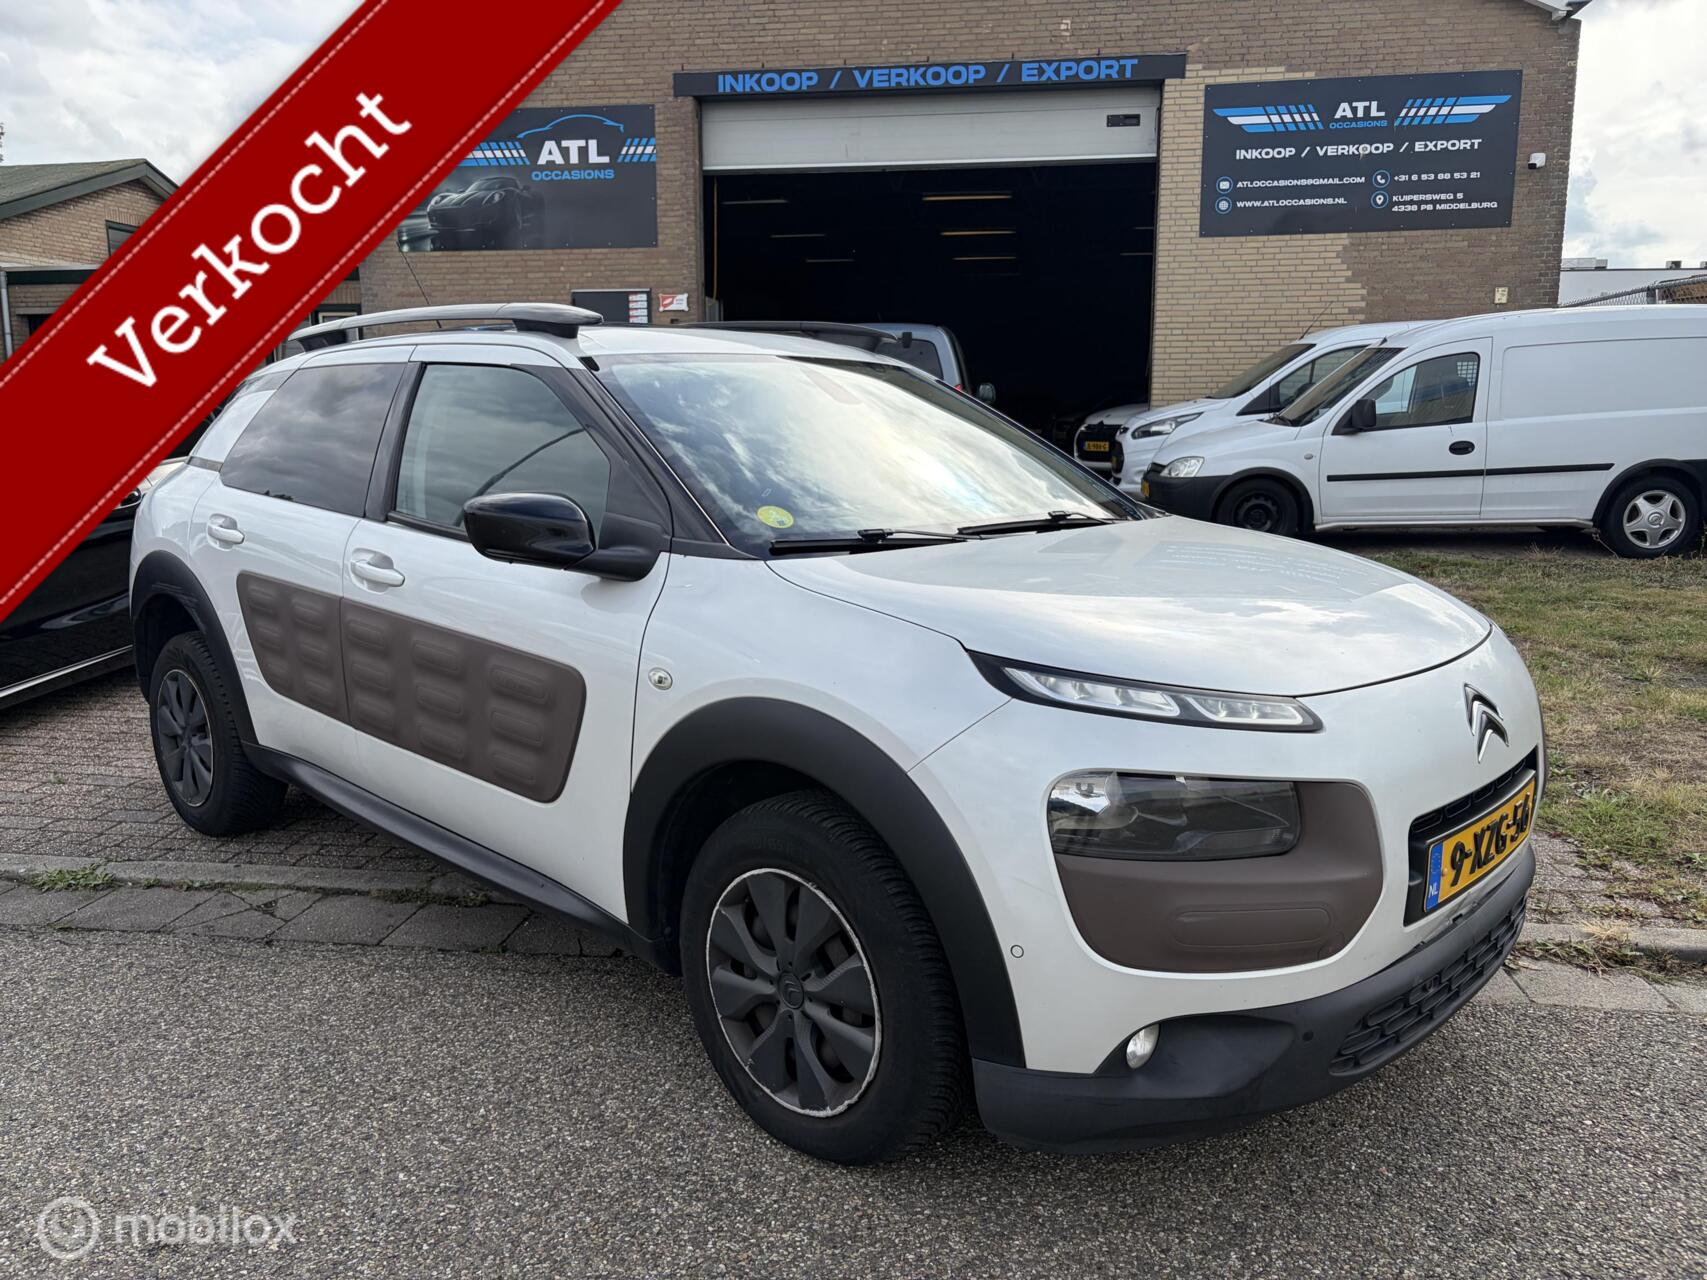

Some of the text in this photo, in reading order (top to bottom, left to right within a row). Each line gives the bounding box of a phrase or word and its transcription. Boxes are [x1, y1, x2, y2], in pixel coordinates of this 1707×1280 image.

[717, 59, 1138, 93] INKOOP / VERKOOP / EXPORT
[1334, 101, 1386, 119] ATL
[1329, 120, 1388, 129] OCCASIONS
[536, 139, 610, 165] ATL
[1236, 139, 1482, 160] INKOOP / VERKOOP / EXPORT
[531, 169, 615, 182] OCCASIONS
[1394, 174, 1409, 182] +31
[1236, 176, 1366, 188] ATLOCCASIONS@GMAIL.COM
[1236, 197, 1348, 208] WWW.ATLOCCASIONS.NL
[1392, 193, 1454, 202] KUIPERSWEG
[1435, 201, 1498, 210] MIDDELBURG
[1428, 882, 1439, 898] NL
